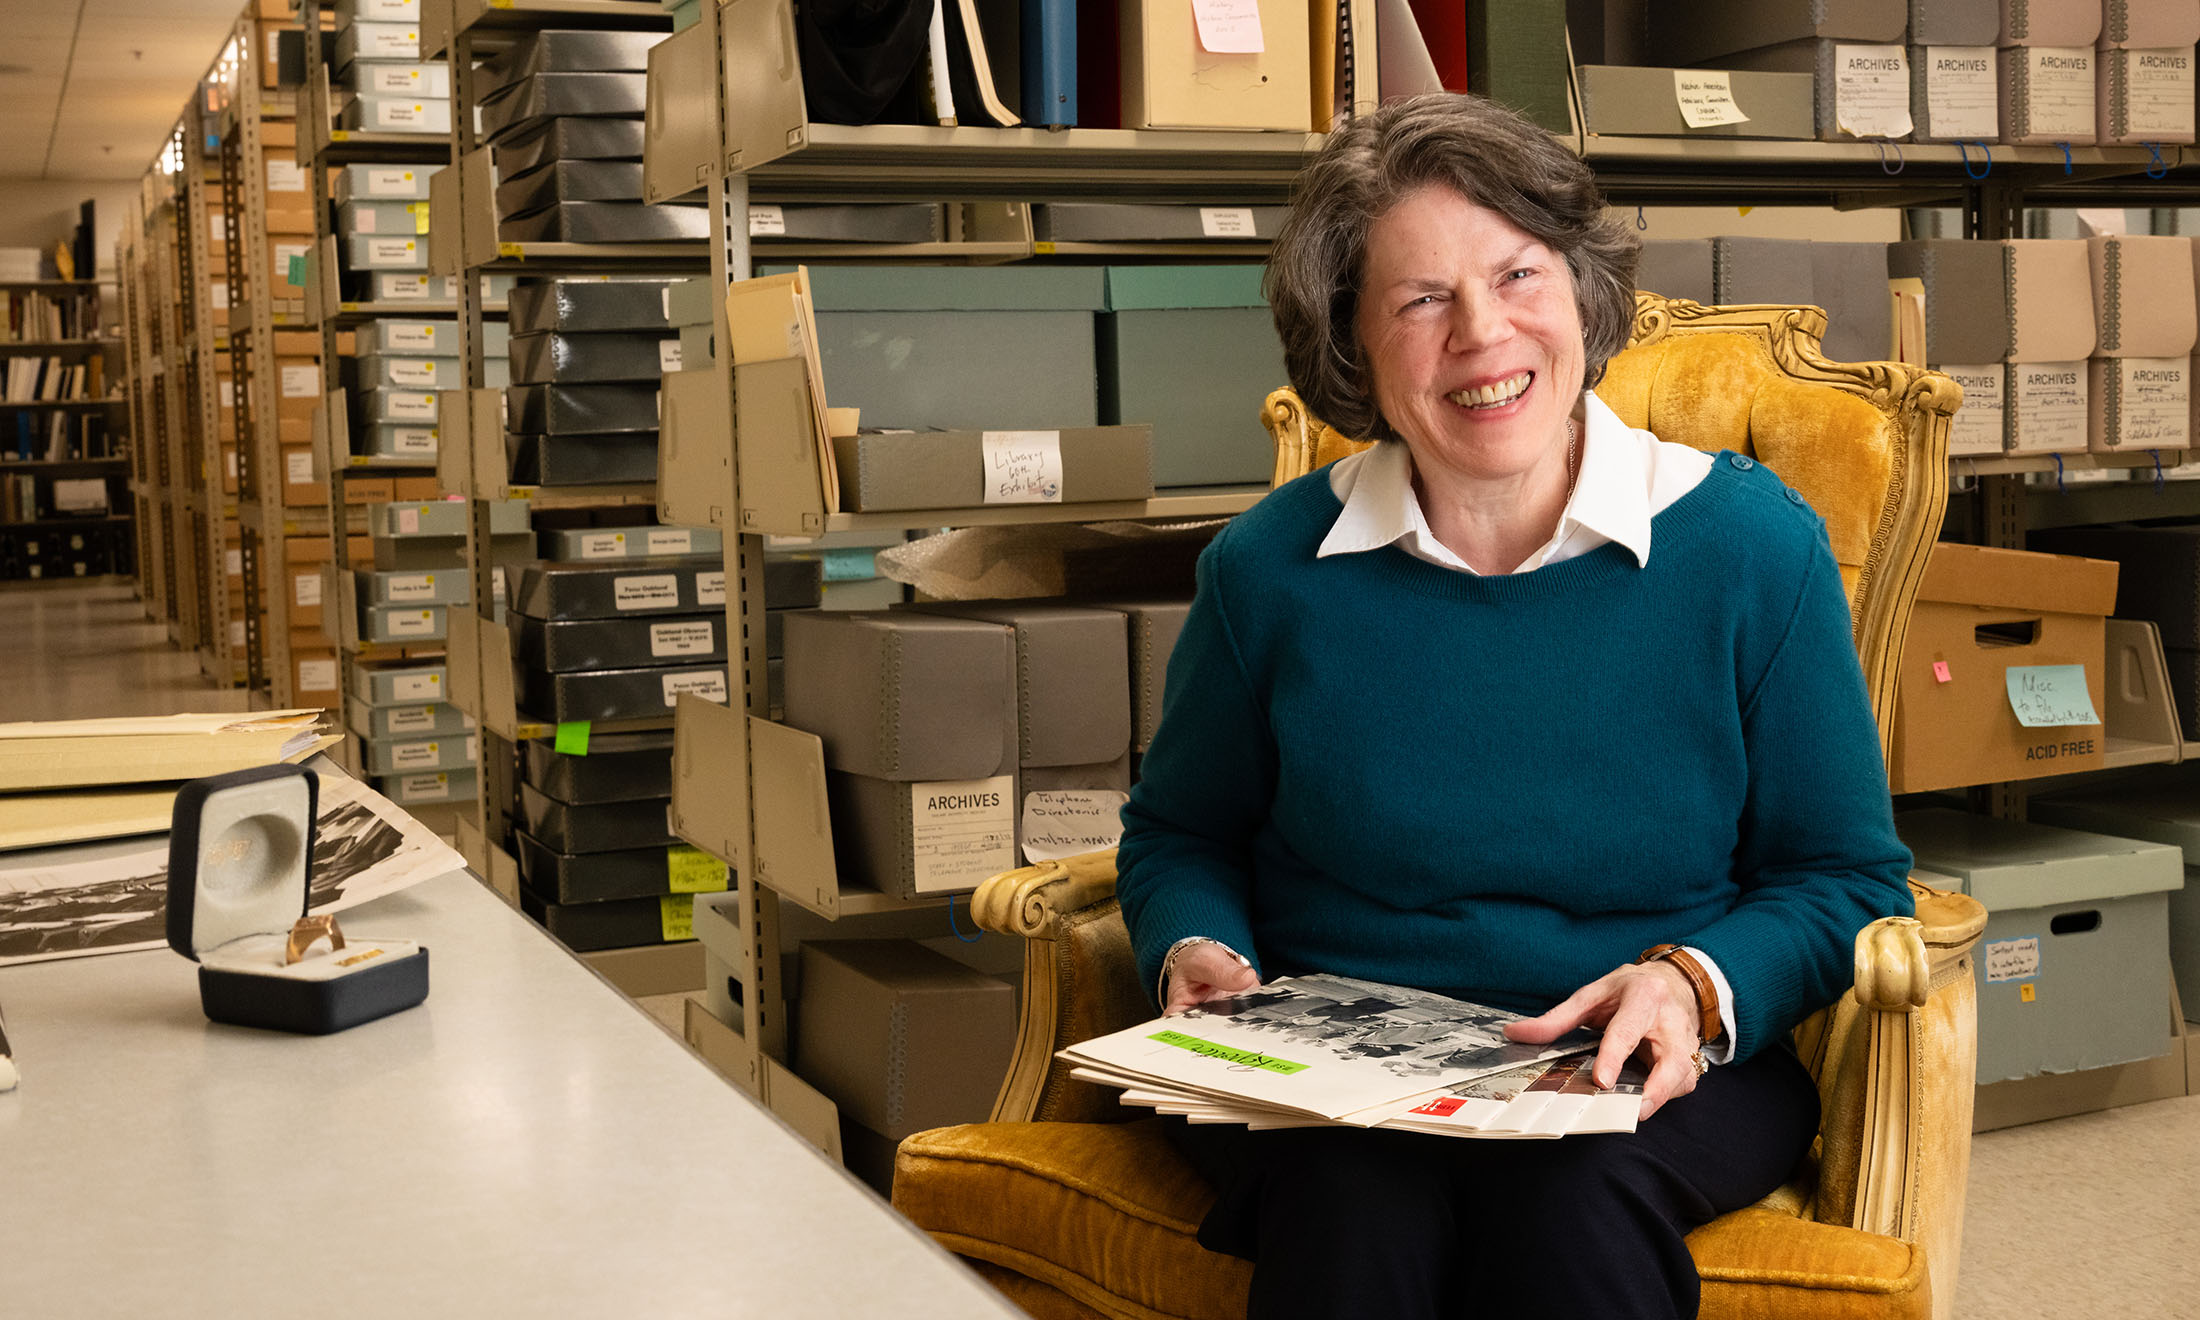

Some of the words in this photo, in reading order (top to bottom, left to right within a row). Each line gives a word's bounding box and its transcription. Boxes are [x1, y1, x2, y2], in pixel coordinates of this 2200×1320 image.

[1849, 58, 1900, 71] ARCHIVES
[1937, 59, 1987, 72] ARCHIVES
[2040, 57, 2088, 70] ARCHIVES
[2139, 56, 2187, 69] ARCHIVES
[2027, 373, 2077, 385] ARCHIVES
[2133, 370, 2181, 382] ARCHIVES
[2026, 745, 2058, 760] ACID
[2061, 740, 2094, 757] FREE
[928, 793, 1000, 810] ARCHIVES
